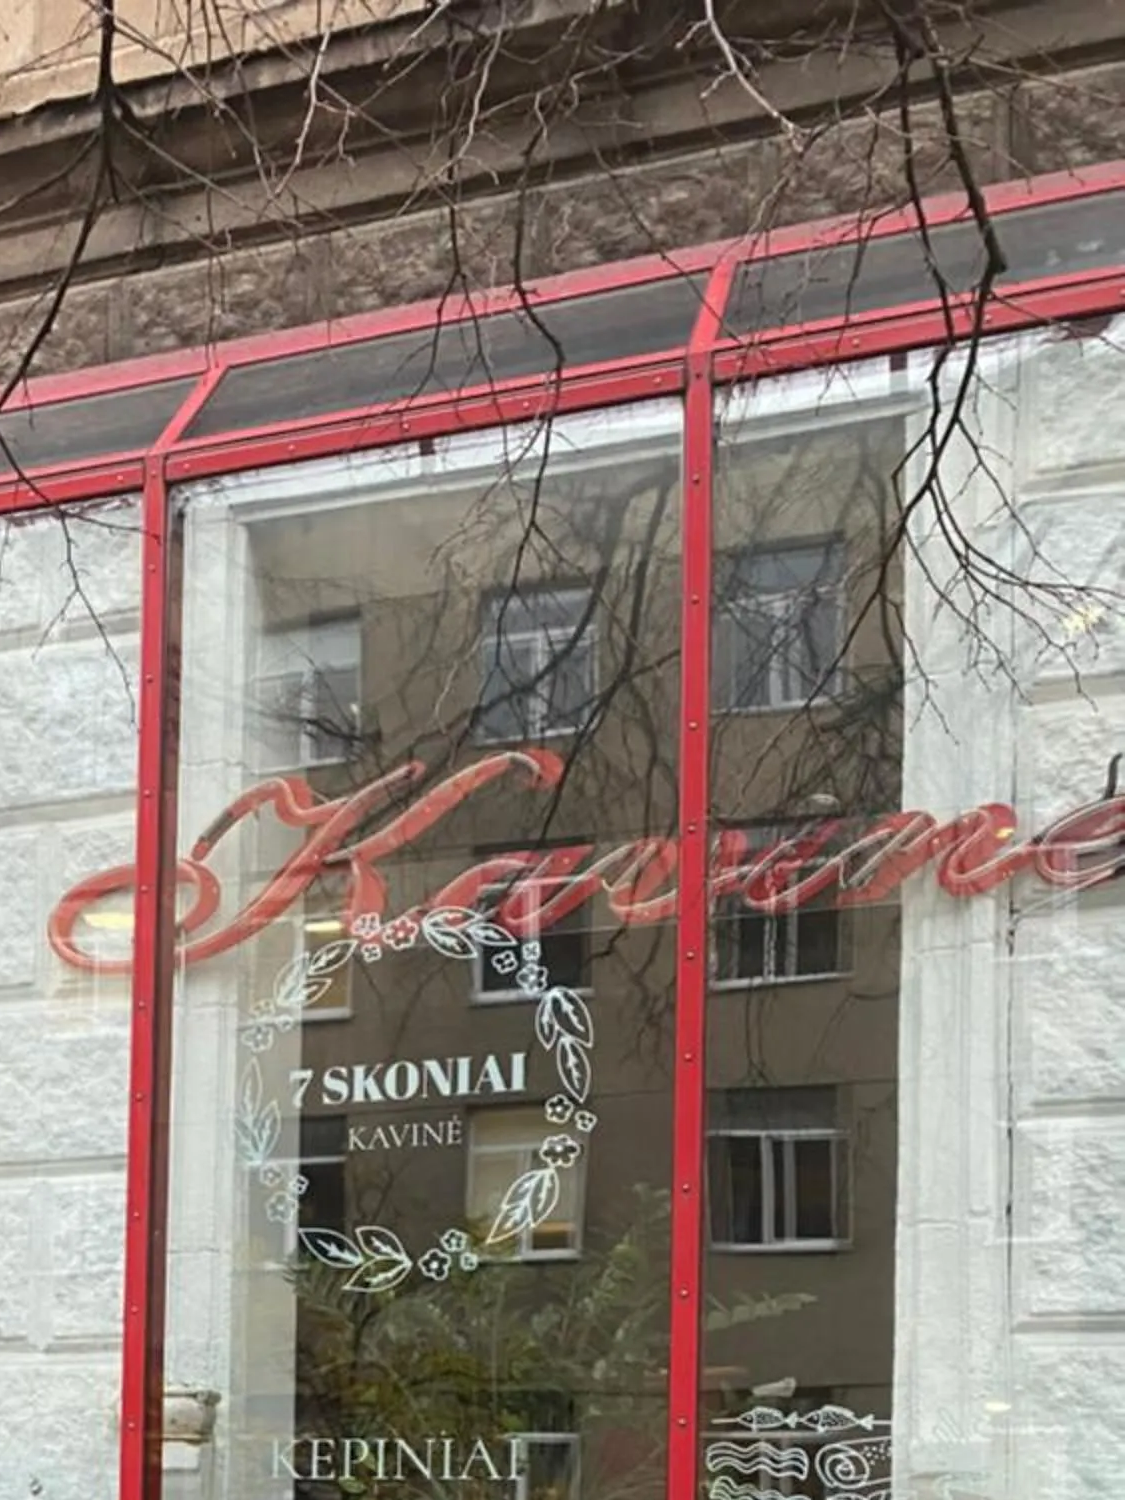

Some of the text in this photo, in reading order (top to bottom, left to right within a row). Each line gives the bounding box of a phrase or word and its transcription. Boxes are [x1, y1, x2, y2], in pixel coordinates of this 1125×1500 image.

[289, 1052, 527, 1108] 7 SKONIAI
[347, 1113, 463, 1152] KAVINĖ
[271, 1437, 523, 1480] KEPINIAI
